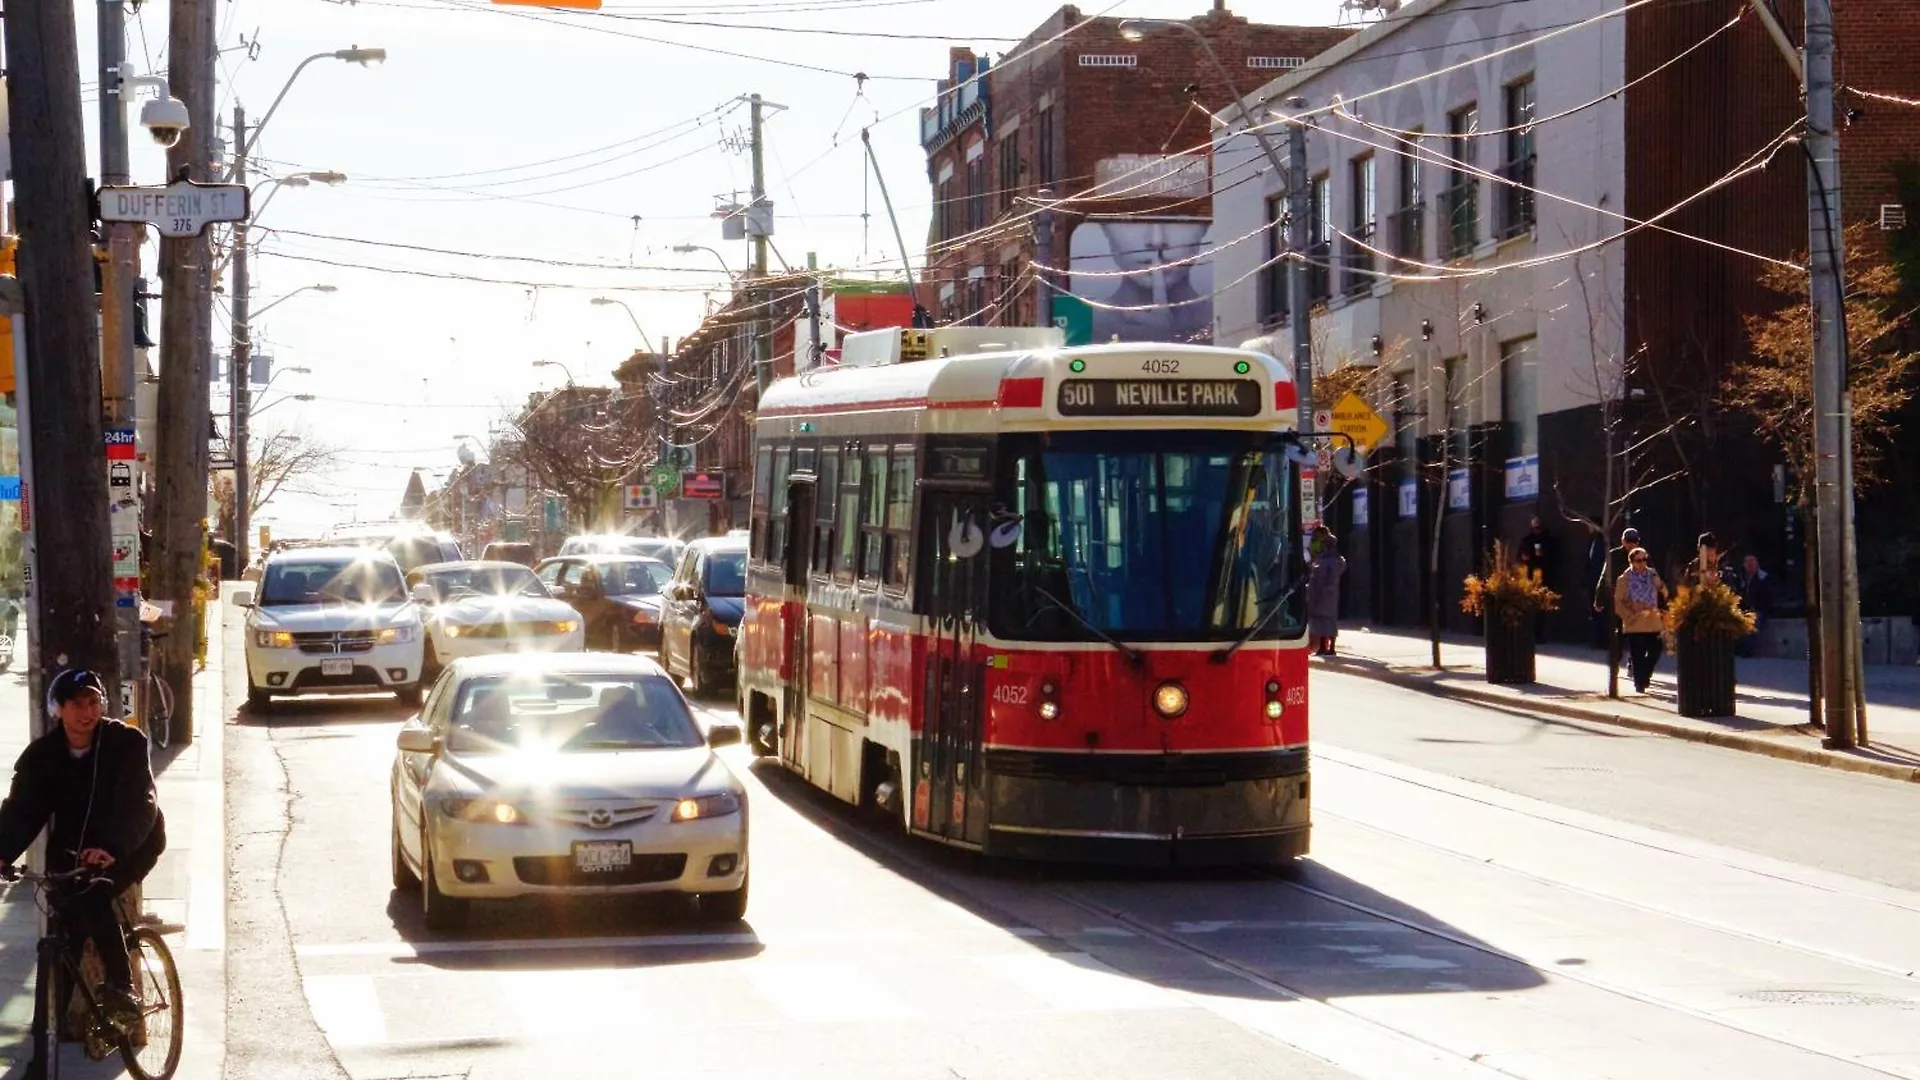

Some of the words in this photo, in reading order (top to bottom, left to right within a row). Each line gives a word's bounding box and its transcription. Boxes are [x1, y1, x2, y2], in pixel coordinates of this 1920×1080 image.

[118, 192, 202, 216] DUFFERIN
[173, 218, 192, 232] 376
[1141, 359, 1180, 374] 4052
[1064, 383, 1095, 406] 501
[1116, 382, 1189, 406] NEVILLE
[1192, 381, 1240, 405] PARK
[104, 431, 135, 444] 24hr
[992, 684, 1028, 704] 4052
[1286, 685, 1306, 705] 4052
